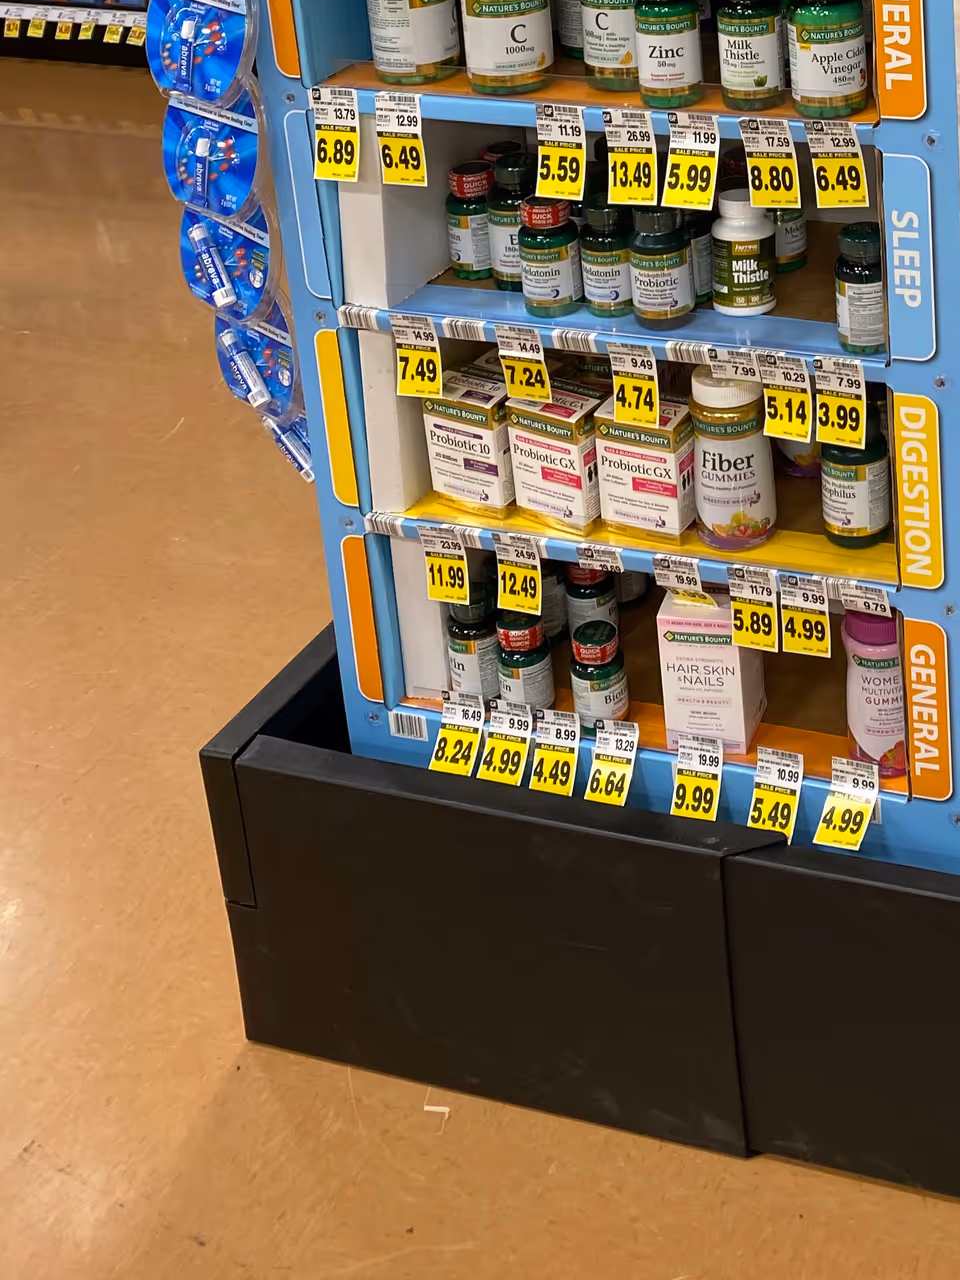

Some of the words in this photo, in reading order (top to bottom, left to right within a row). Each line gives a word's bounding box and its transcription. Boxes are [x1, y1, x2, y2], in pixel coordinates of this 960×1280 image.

[482, 4, 519, 13] NATURE'S
[595, 12, 609, 30] C
[666, 21, 691, 30] BOUNTY
[740, 24, 767, 33] BOUNTY
[510, 24, 528, 44] C
[810, 30, 843, 40] NATURE'S
[648, 45, 684, 59] Zinc
[727, 39, 752, 50] Milk
[180, 44, 189, 76] abreva
[724, 49, 760, 61] Thistle
[811, 52, 843, 66] Apple
[846, 46, 865, 60] Cider
[822, 61, 862, 75] Vinegar
[692, 130, 717, 145] 11.99
[765, 136, 790, 149] 17.59
[830, 136, 856, 149] 12.99
[317, 138, 355, 166] 6.89
[381, 144, 421, 171] 6.49
[539, 155, 580, 183] 5.59
[610, 160, 651, 189] 13.49
[195, 162, 203, 193] abreva
[667, 164, 712, 192] 5.99
[750, 166, 794, 192] 8.80
[816, 165, 862, 192] 6.49
[655, 257, 680, 267] BOUNTY
[732, 259, 759, 272] Milk
[891, 209, 922, 308] SLEEP
[201, 252, 220, 285] abreva
[634, 276, 679, 288] Probiotic
[732, 269, 770, 285] Thistle
[412, 330, 435, 342] 14.99
[517, 341, 541, 355] 14.49
[399, 356, 437, 383] 7.49
[630, 357, 653, 370] 9.49
[731, 365, 756, 378] 7.99
[505, 365, 546, 389] 7.24
[781, 370, 806, 383] 10.29
[836, 376, 861, 390] 7.99
[615, 383, 655, 412] 4.74
[434, 403, 461, 418] NATURE'S
[461, 410, 487, 422] BOUNTY
[766, 395, 807, 425] 5.14
[818, 402, 861, 432] 3.99
[518, 416, 546, 431] NATURE'S
[547, 424, 573, 438] BOUNTY
[726, 420, 757, 433] BOUNTY
[430, 430, 478, 453] Probiotic
[479, 443, 491, 455] 10
[609, 427, 640, 441] NATURE'S
[640, 434, 669, 446] BOUNTY
[513, 443, 559, 467] Probiotic
[559, 456, 577, 471] GX
[701, 449, 755, 473] Fiber
[601, 455, 652, 476] Probiotic
[653, 466, 674, 480] GX
[830, 469, 855, 479] BOUNTY
[701, 469, 756, 484] GUMMIES
[900, 406, 932, 577] DIGESTION
[440, 540, 462, 551] 23.99
[514, 548, 537, 561] 24.99
[428, 563, 465, 591] 11.99
[675, 574, 698, 586] 19.99
[500, 571, 537, 600] 12.49
[749, 584, 773, 597] 11.79
[802, 591, 826, 605] 9.99
[863, 601, 887, 614] 9.79
[732, 608, 773, 637] 5.89
[784, 616, 826, 643] 4.99
[675, 634, 704, 642] NATURE'S
[705, 636, 731, 644] BOUNTY
[703, 665, 735, 676] SKIN
[861, 660, 894, 669] NATURE'S
[683, 675, 725, 687] NAILS
[861, 674, 900, 687] WOME
[461, 710, 482, 722] 16.49
[910, 644, 940, 776] GENERAL
[508, 718, 530, 732] 9.99
[555, 728, 576, 742] 8.99
[434, 736, 473, 767] 8.24
[614, 737, 635, 753] 13.29
[482, 747, 522, 777] 4.99
[698, 753, 720, 768] 19.99
[533, 759, 571, 787] 4.49
[776, 768, 800, 784] 10.99
[589, 768, 626, 798] 6.64
[852, 776, 875, 792] 9.99
[674, 784, 714, 815] 9.99
[750, 798, 792, 831] 5.49
[821, 805, 865, 836] 4.99
